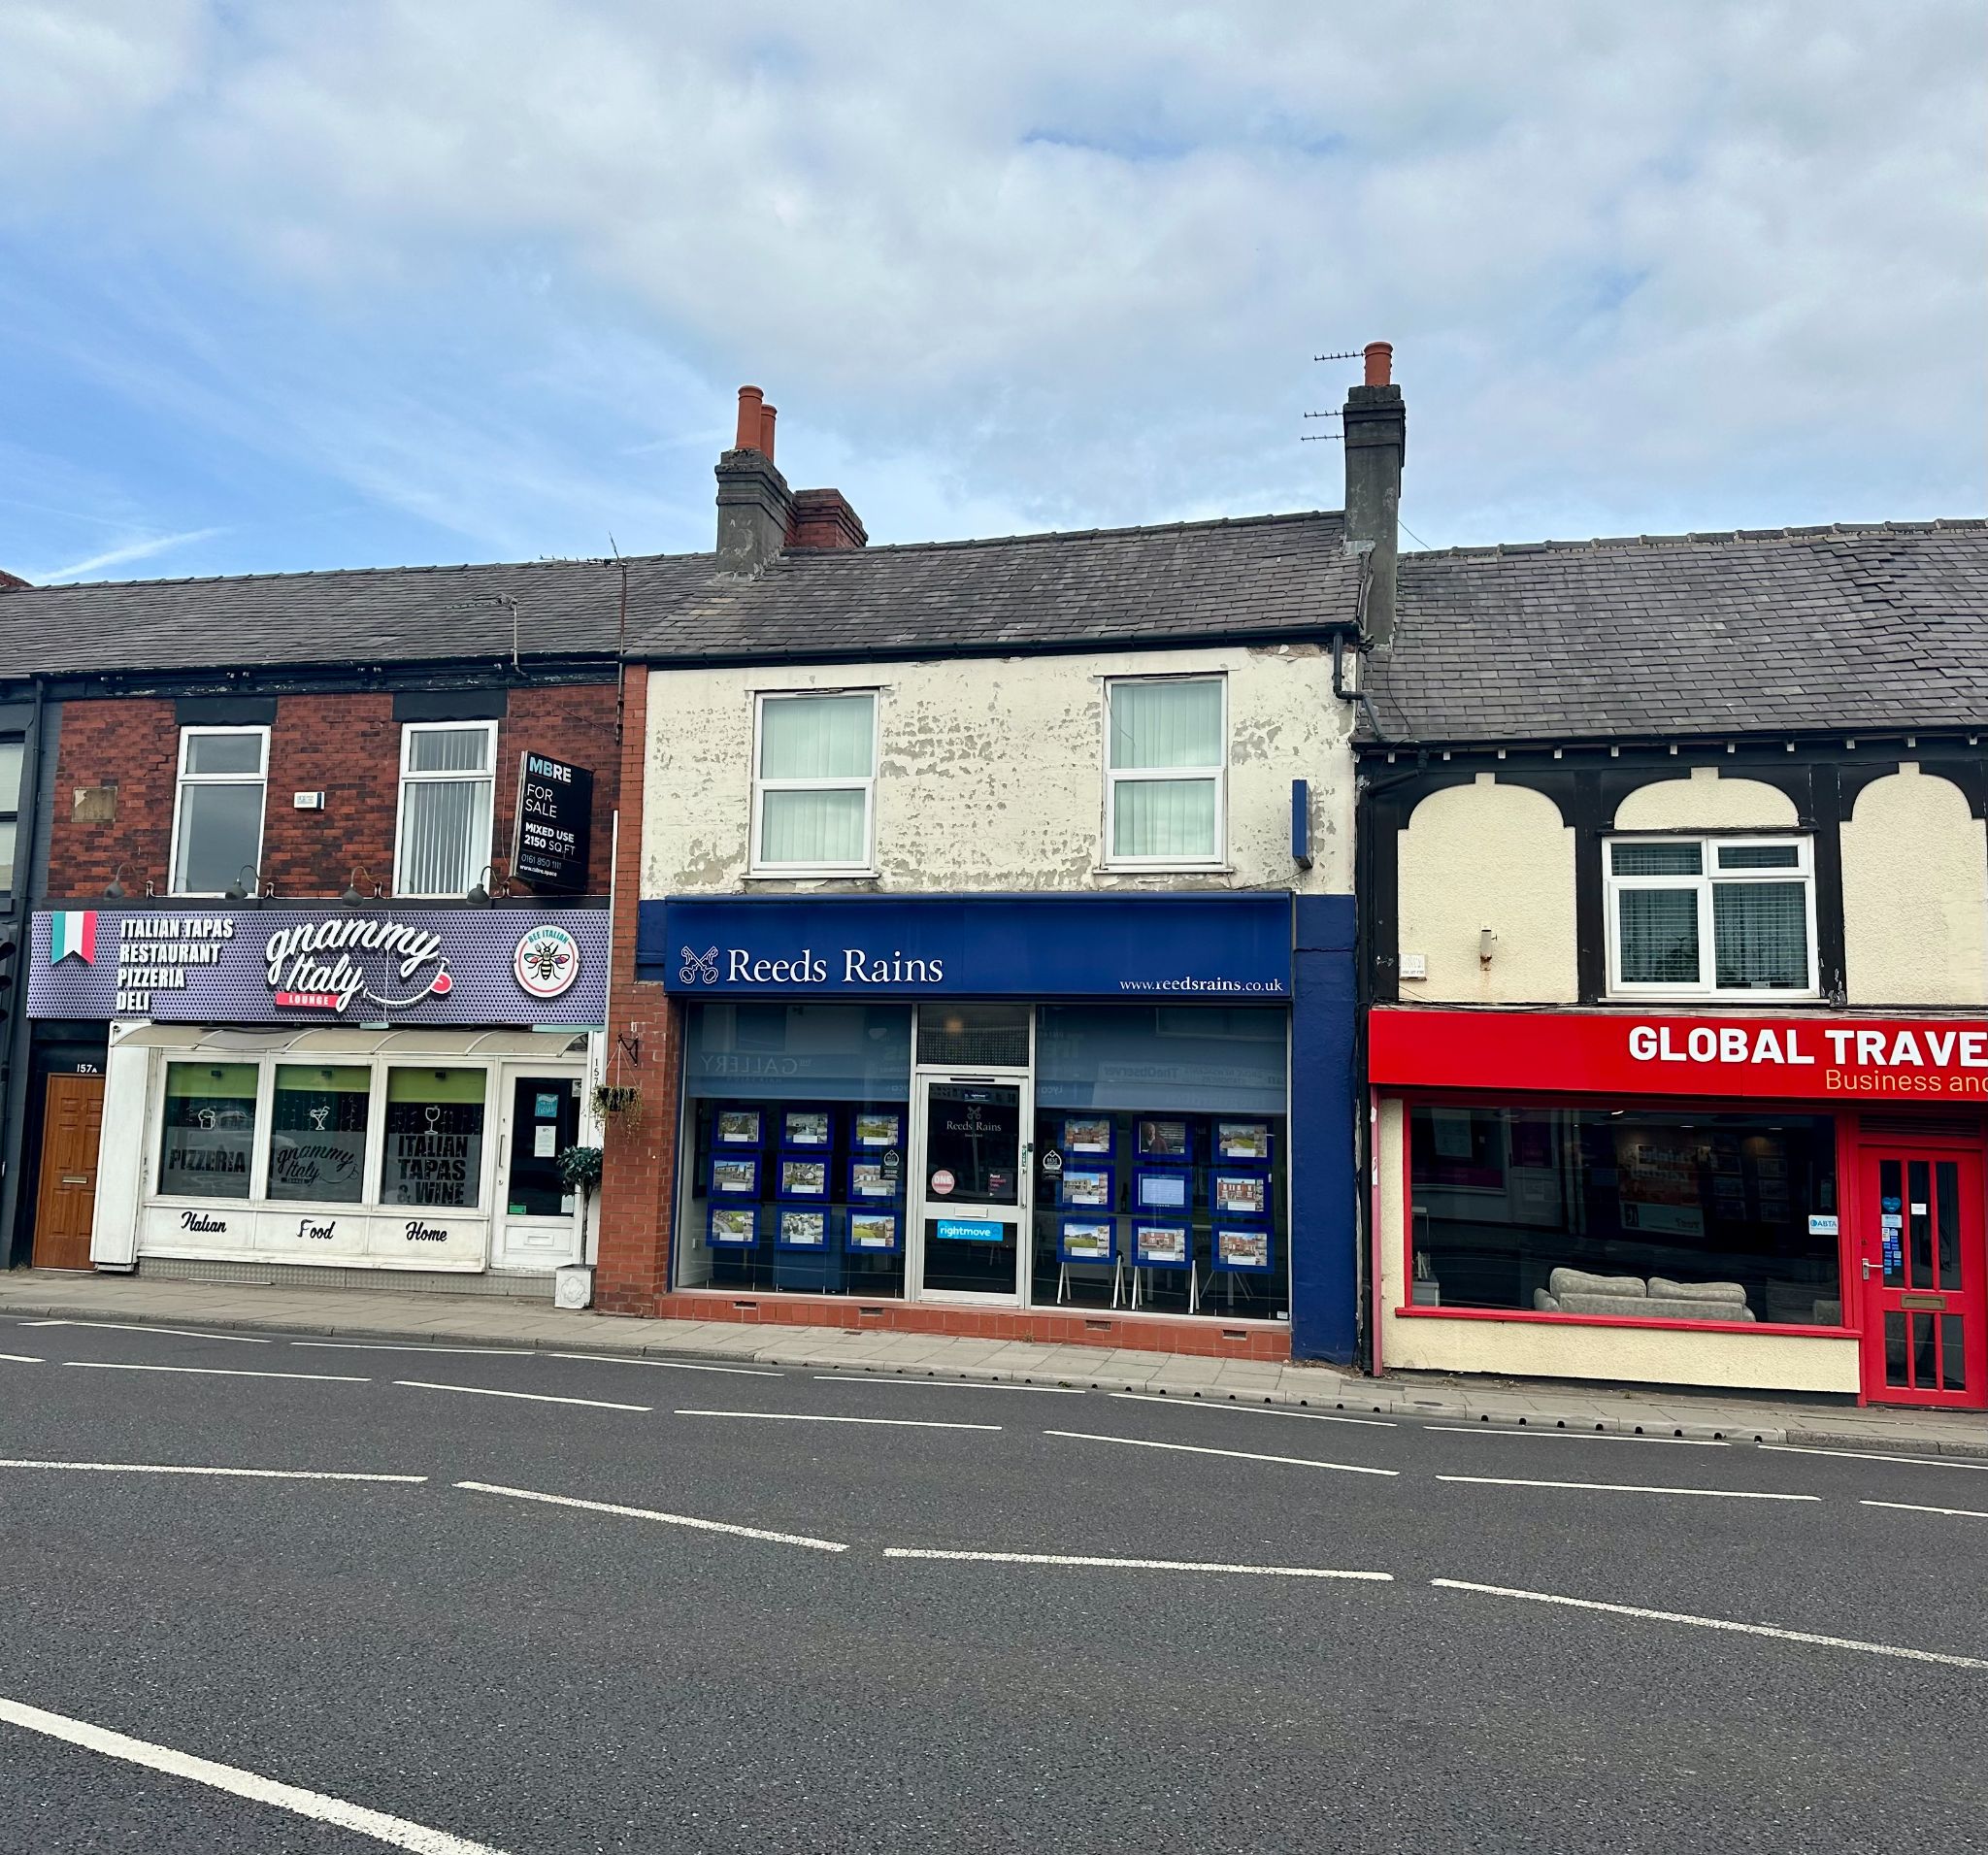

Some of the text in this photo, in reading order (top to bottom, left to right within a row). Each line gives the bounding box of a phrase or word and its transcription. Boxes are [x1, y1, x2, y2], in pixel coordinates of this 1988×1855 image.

[529, 756, 572, 783] MBRE
[526, 783, 553, 803] FOR
[525, 799, 557, 818] SALE
[524, 835, 547, 848] 2150
[525, 821, 575, 844] MIXED USE
[521, 853, 536, 865] 0161
[536, 857, 550, 868] 850
[120, 918, 234, 939] ITALIAN TAPAS
[527, 929, 570, 944] BEE ITALIAN
[119, 944, 221, 964] RESTAURANT
[265, 918, 441, 985] gnammy
[726, 949, 944, 983] Reeds Rains
[117, 968, 185, 988] PIZZERIA
[286, 953, 364, 1012] Italy
[1119, 977, 1283, 992] www.reedsrains.co.uk
[116, 991, 149, 1010] DELI
[288, 994, 329, 1006] LOUNGE
[1629, 1025, 1988, 1068] GLOBAL TRAVE
[77, 1063, 98, 1074] 157A
[1825, 1069, 1941, 1092] Business
[946, 1120, 1002, 1132] Reeds Rains
[398, 1135, 469, 1158] ITALIAN
[168, 1148, 246, 1174] PIZZERIA
[277, 1144, 355, 1175] gnammy
[397, 1158, 466, 1181] TAPAS
[285, 1161, 320, 1187] Italy
[934, 1175, 952, 1184] ONE
[396, 1181, 465, 1205] & WINE
[181, 1210, 227, 1234] Italian
[296, 1218, 336, 1241] Food
[405, 1221, 447, 1242] Home
[940, 1225, 991, 1238] rightmove
